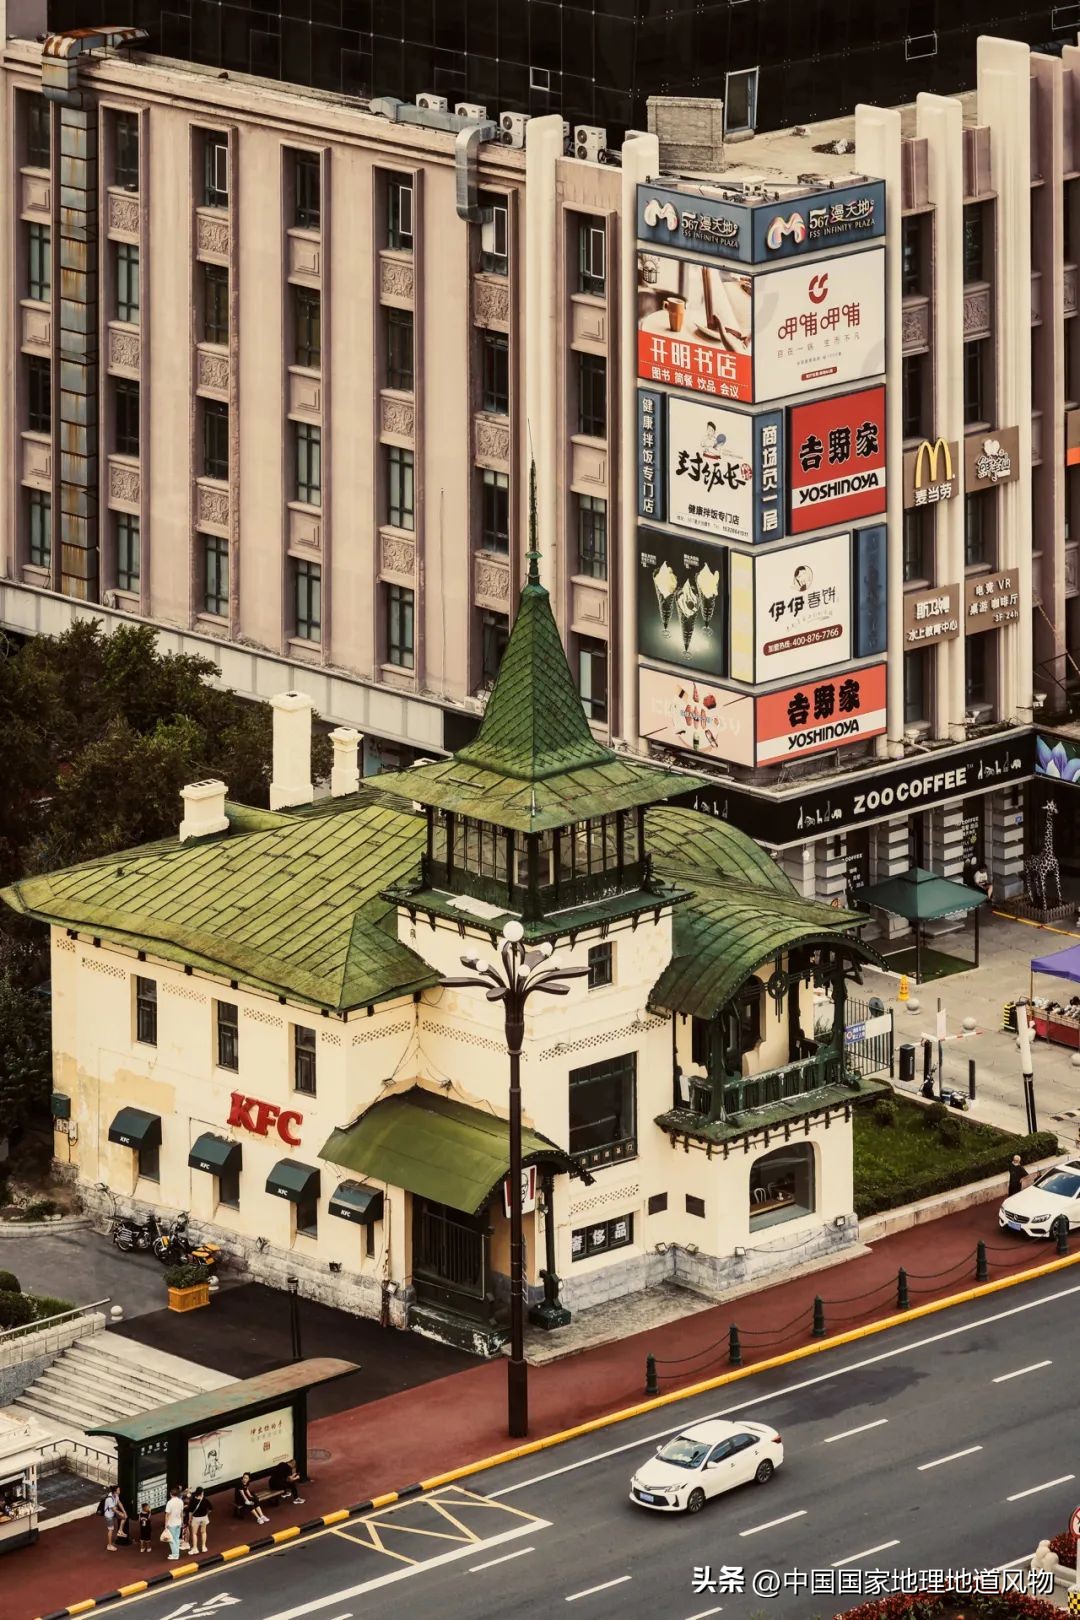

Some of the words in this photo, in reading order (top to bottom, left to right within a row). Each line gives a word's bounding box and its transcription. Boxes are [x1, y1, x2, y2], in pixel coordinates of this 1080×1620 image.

[693, 232, 719, 243] INFINITY
[720, 238, 739, 248] PLAZA
[824, 223, 852, 236] INFINITY
[855, 218, 875, 228] PLAZA
[778, 302, 860, 341] 呷哺呷哺
[650, 337, 737, 380] 开明书店
[652, 367, 671, 382] 图书
[674, 371, 693, 387] 简餐
[697, 377, 716, 392] 饮品
[720, 382, 739, 398] 会议
[643, 398, 655, 514] 健康拌饭专门店
[800, 421, 879, 472] 吉野家
[762, 425, 778, 532] 商场负一层
[799, 472, 879, 504] YOSHINOYA
[915, 483, 952, 507] 麦当劳
[688, 504, 740, 526] 健康拌饭专门店
[998, 578, 1011, 590] VR
[769, 586, 836, 622] 伊伊春饼
[788, 679, 860, 727] 吉野家
[788, 719, 859, 750] YOSHINOYA
[853, 786, 894, 814] ZOO
[896, 767, 967, 802] COFFEE
[227, 1092, 304, 1146] KFC
[119, 1136, 130, 1144] KFC
[200, 1162, 210, 1170] KFC
[278, 1188, 288, 1196] KFC
[340, 1209, 351, 1218] KFC
[572, 1221, 627, 1251] 奢侈品
